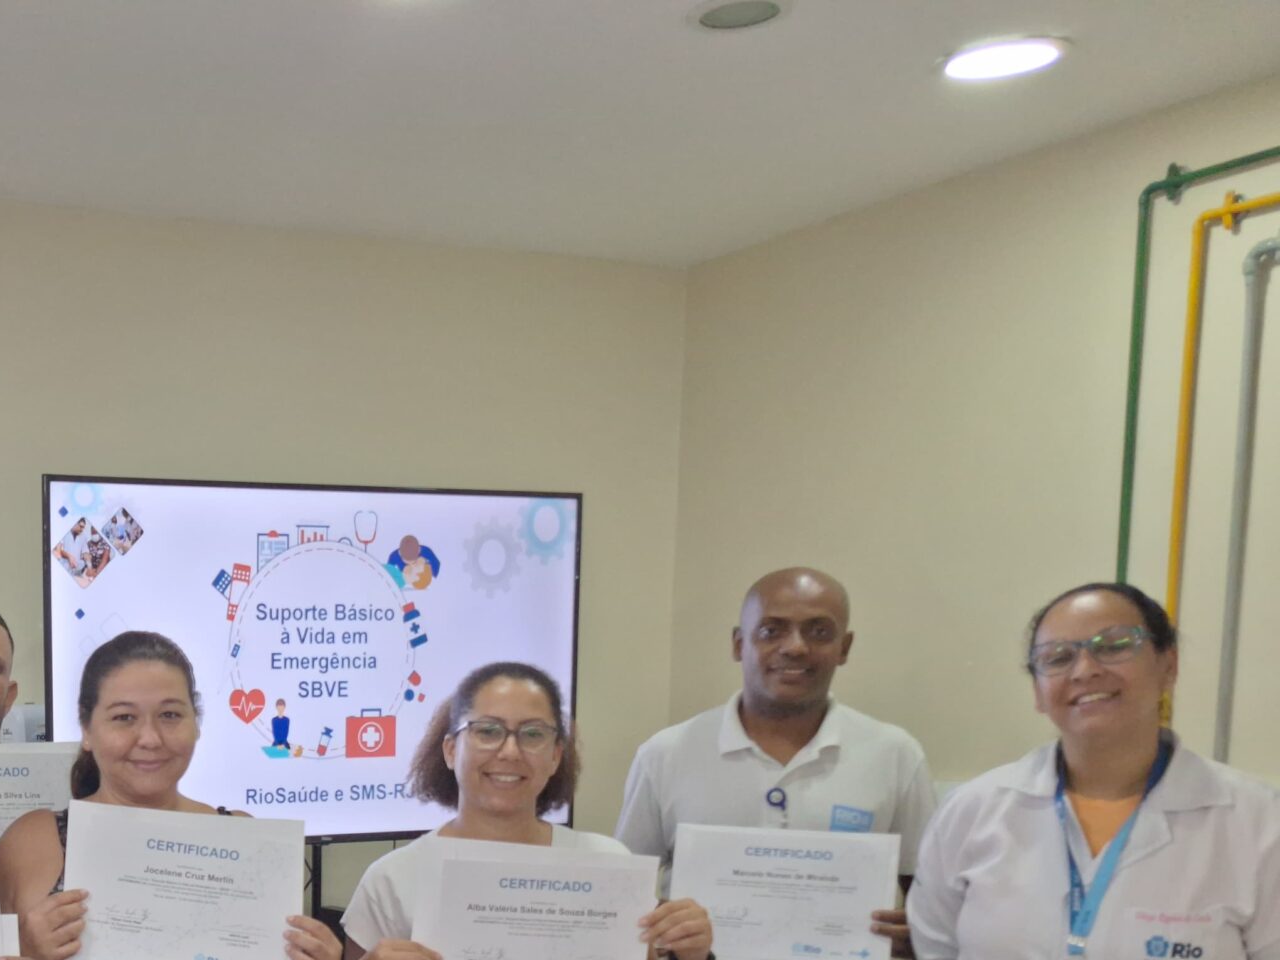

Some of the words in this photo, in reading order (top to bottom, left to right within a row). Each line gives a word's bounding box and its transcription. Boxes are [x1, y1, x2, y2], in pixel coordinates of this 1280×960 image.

[255, 603, 328, 625] Suporte
[334, 602, 396, 623] Básico
[280, 626, 291, 645] à
[296, 627, 337, 645] Vida
[342, 631, 369, 645] em
[270, 652, 378, 674] Emergência
[297, 681, 349, 699] SBVE
[4, 791, 22, 800] Silva
[245, 784, 329, 806] RioSaúde
[334, 789, 344, 803] e
[146, 837, 240, 861] CERTIFICADO
[744, 847, 833, 861] CERTIFICADO
[499, 878, 592, 893] CERTIFICADO
[1171, 942, 1203, 959] Rio
